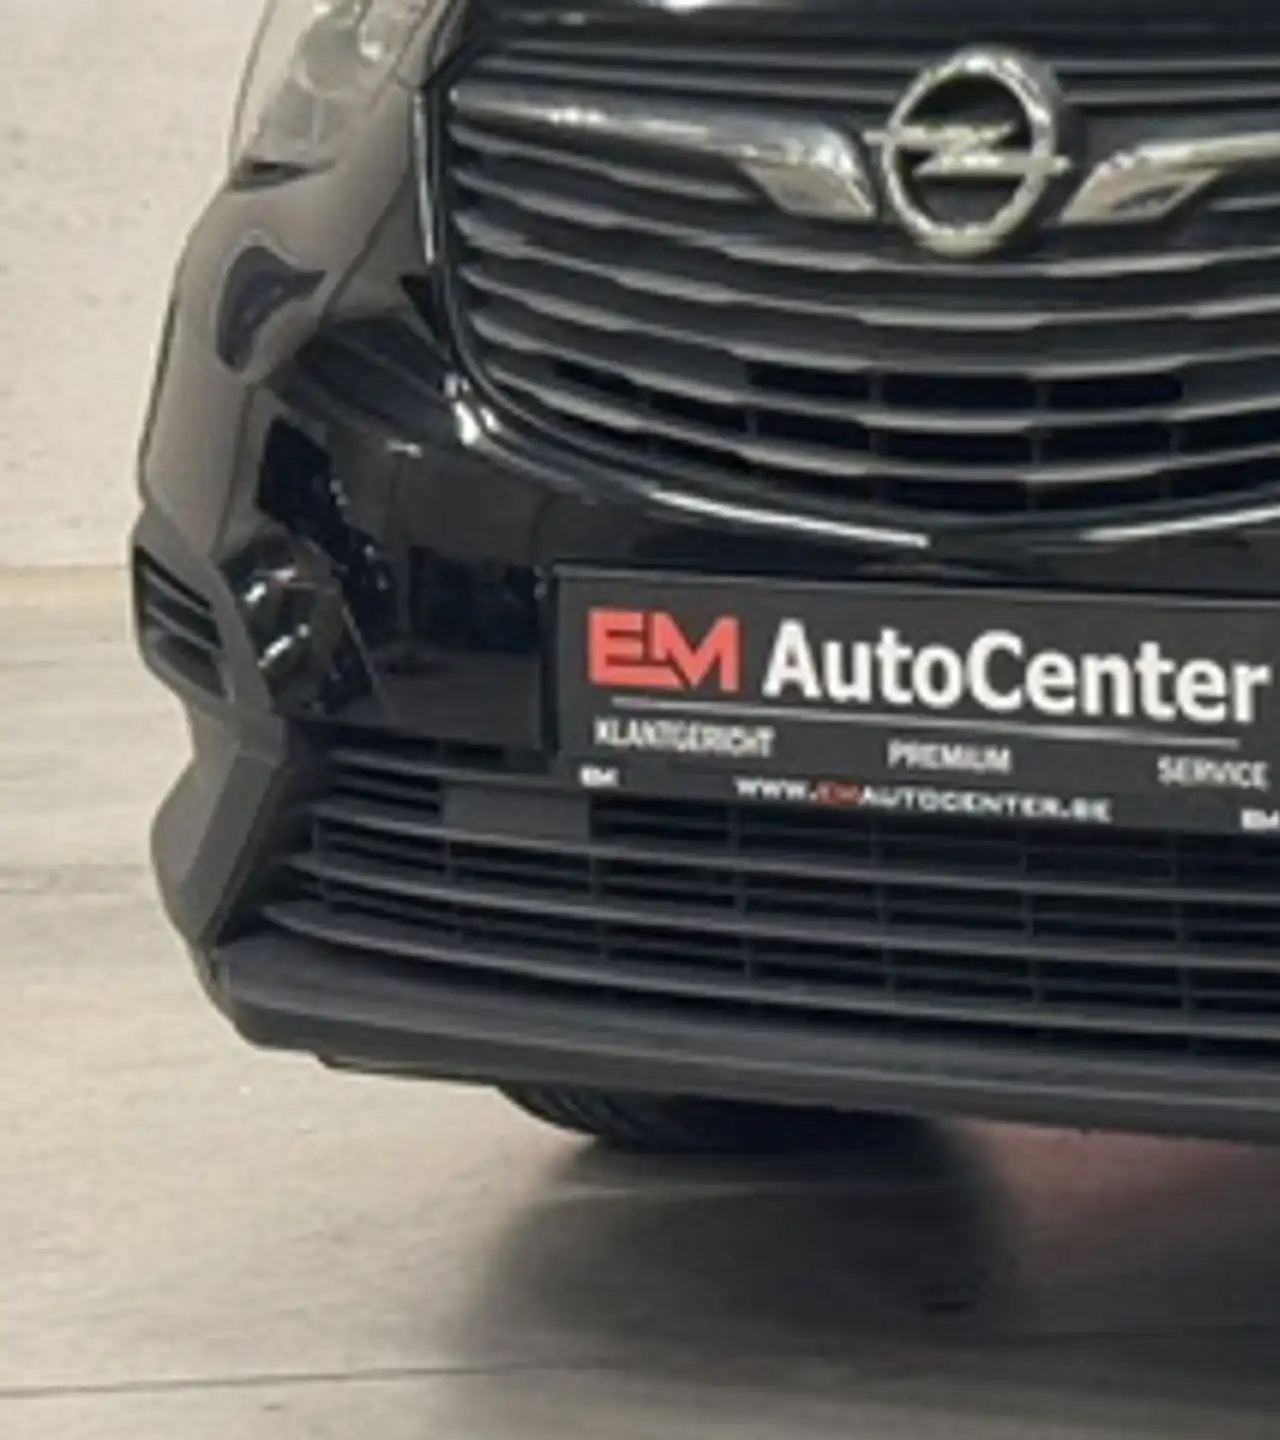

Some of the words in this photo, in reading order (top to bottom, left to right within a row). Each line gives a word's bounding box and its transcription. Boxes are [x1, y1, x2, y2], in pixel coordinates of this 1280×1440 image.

[587, 607, 741, 692] EM
[762, 617, 1272, 724] AutoCenter
[887, 739, 1012, 775] PREMIUM
[1156, 756, 1271, 791] SERVICE
